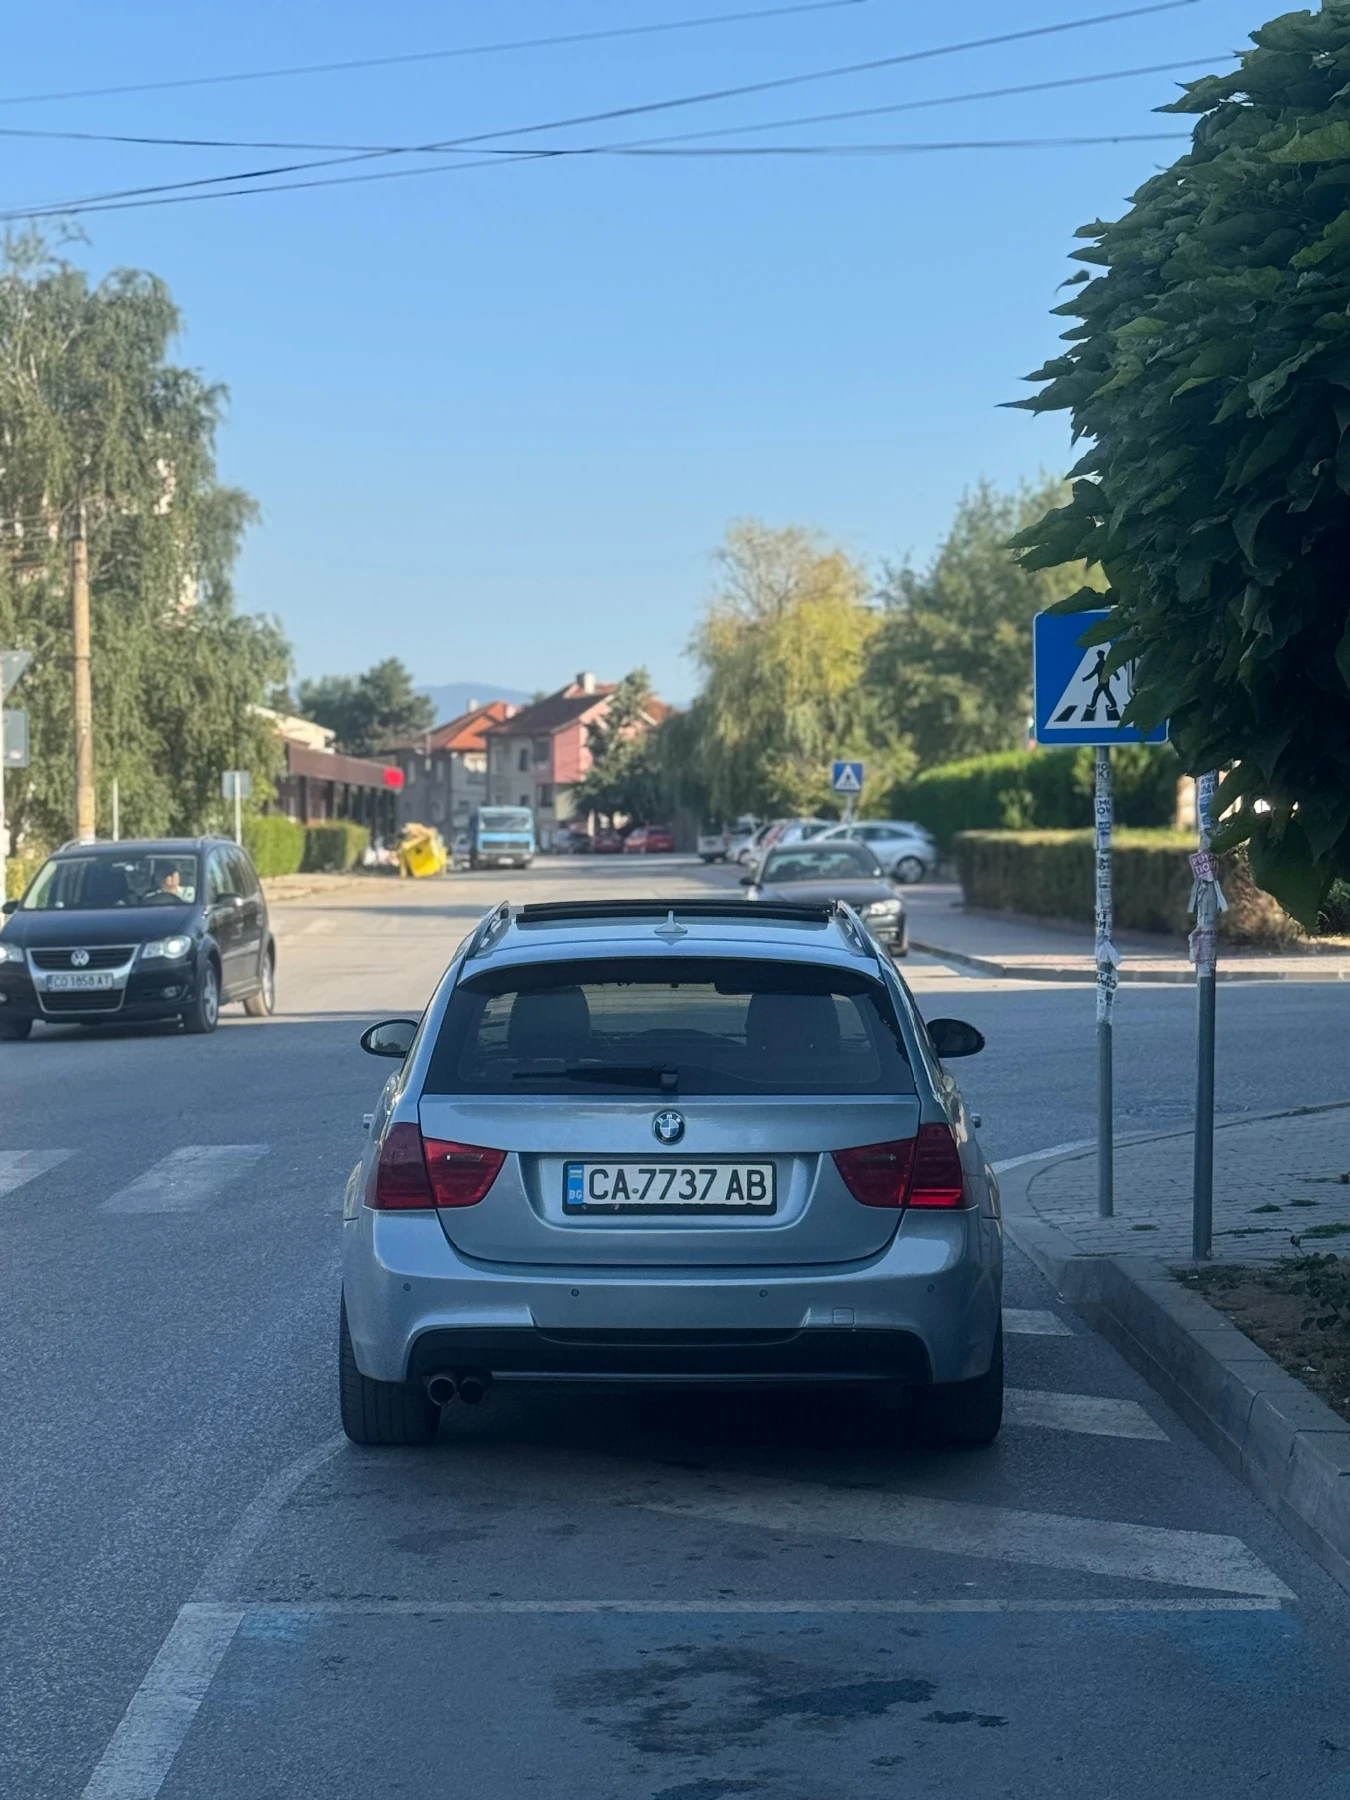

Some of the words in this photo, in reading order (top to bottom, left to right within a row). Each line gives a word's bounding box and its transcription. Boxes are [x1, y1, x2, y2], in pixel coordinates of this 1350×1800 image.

[568, 1189, 583, 1200] BG
[588, 1168, 631, 1201] CA
[637, 1168, 718, 1201] 7737
[724, 1168, 767, 1201] AB
